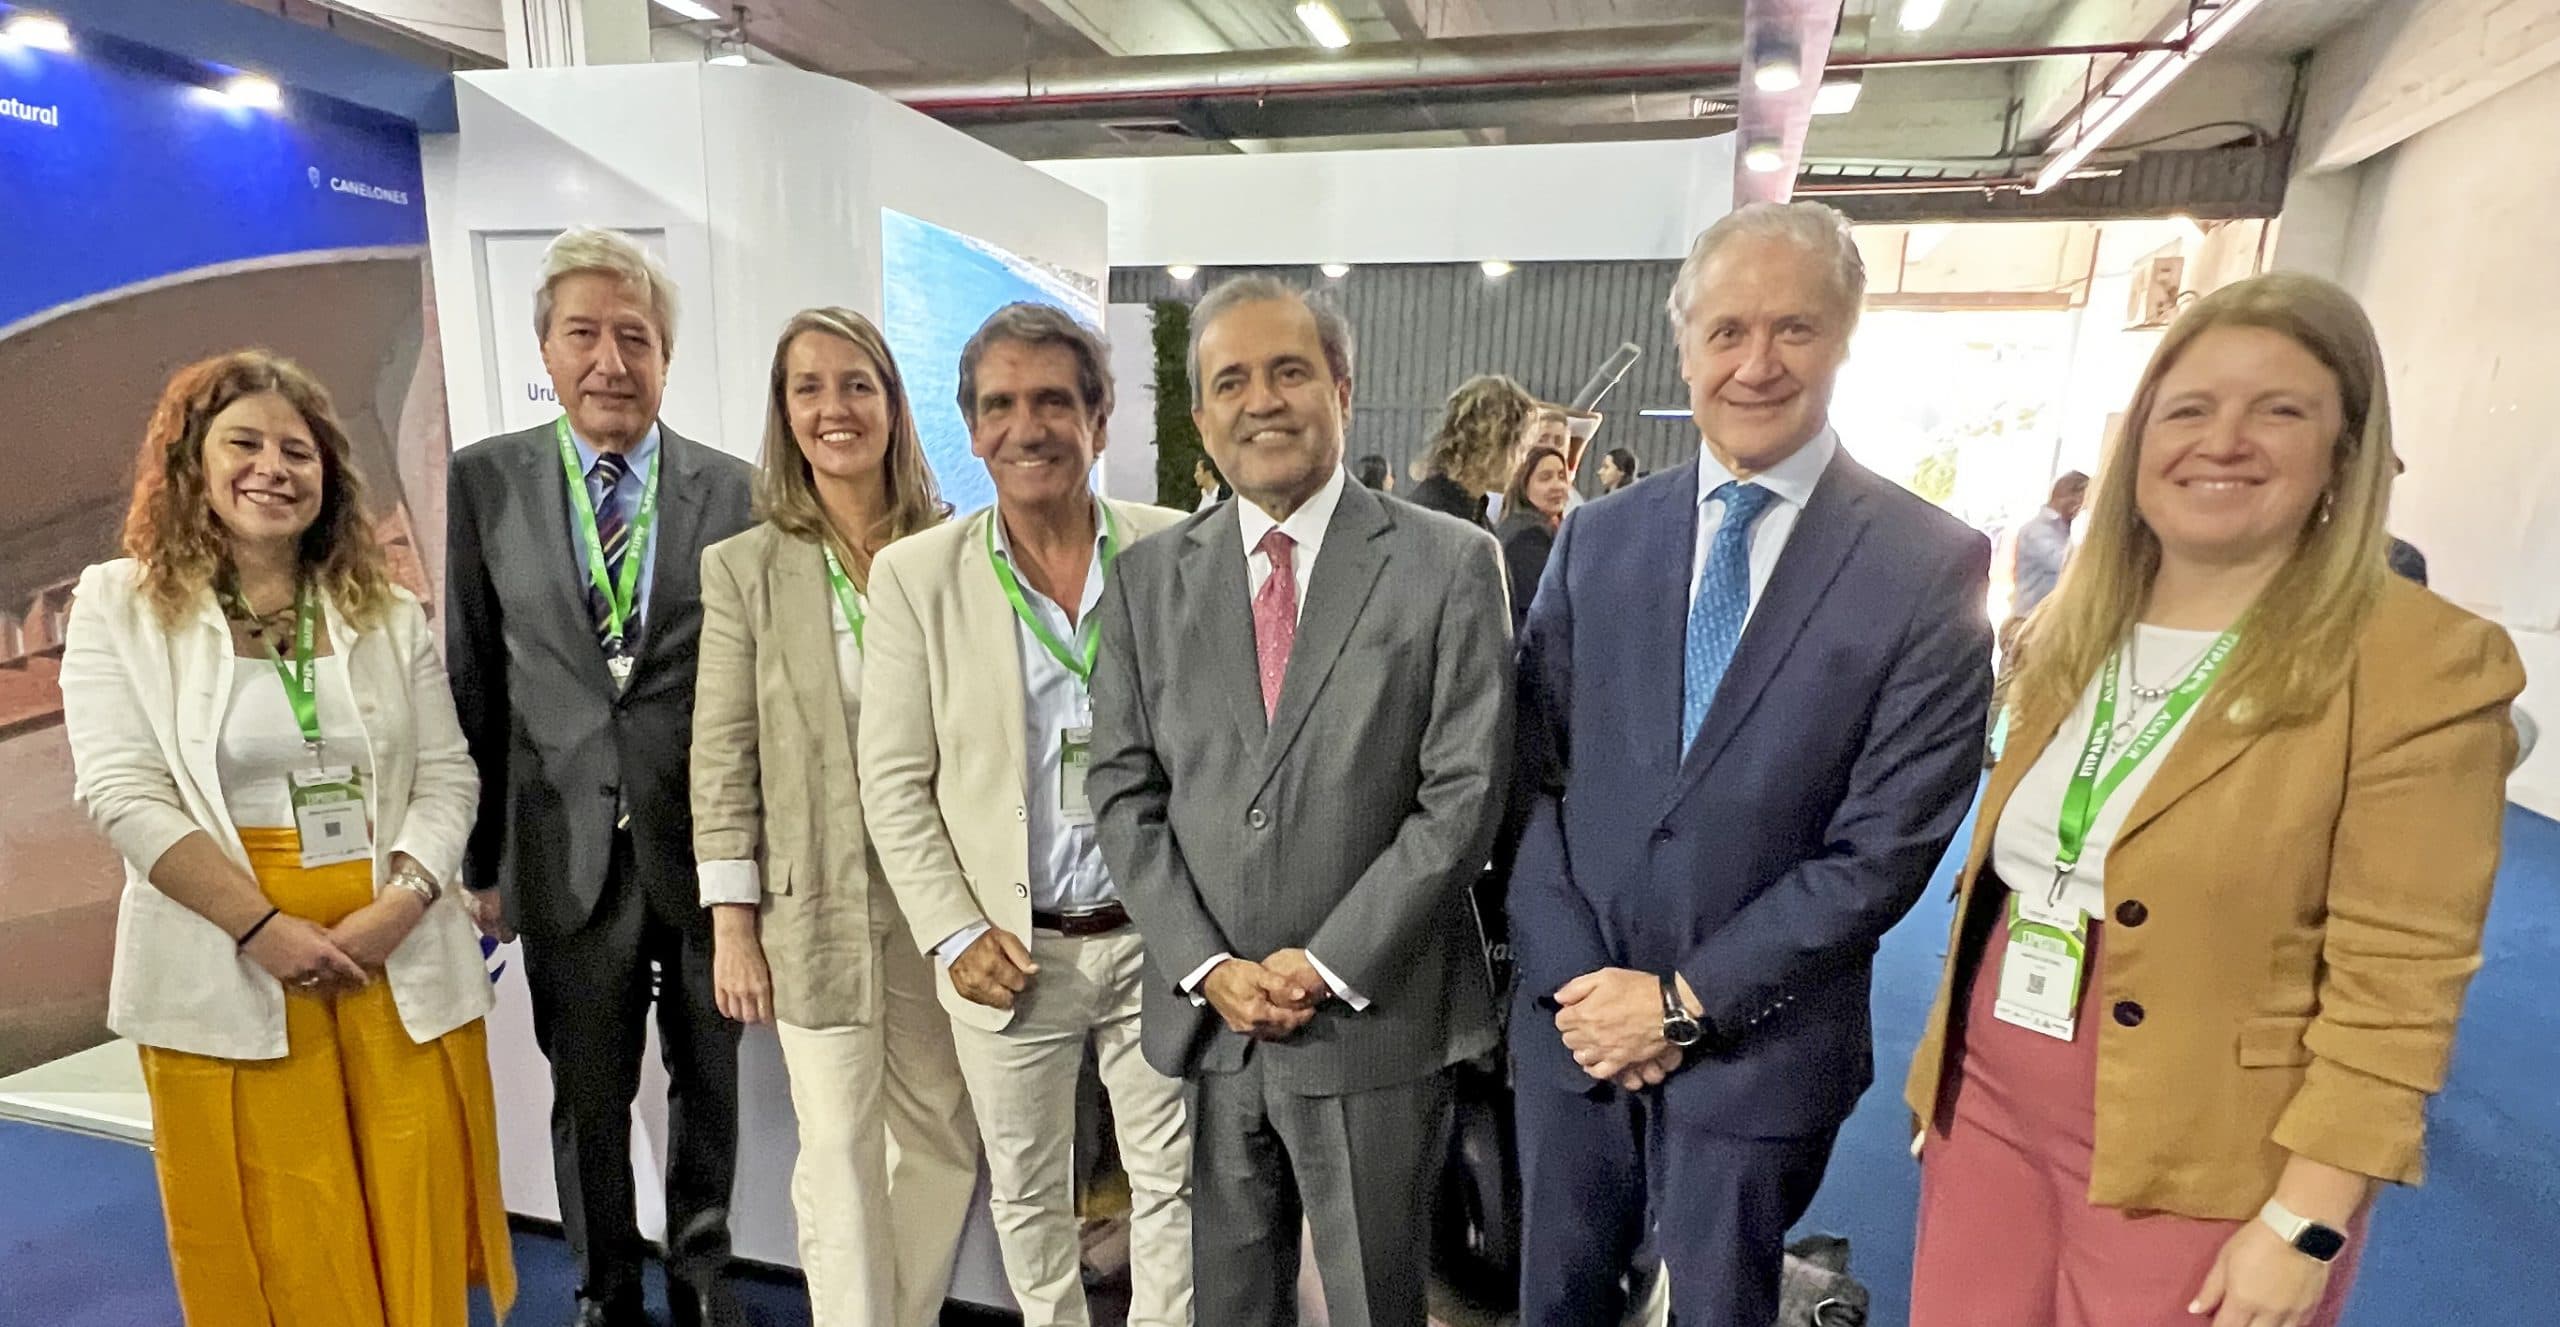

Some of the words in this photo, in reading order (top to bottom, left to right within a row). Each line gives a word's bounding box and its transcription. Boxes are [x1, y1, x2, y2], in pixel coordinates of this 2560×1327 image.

[0, 97, 59, 127] atural
[330, 176, 409, 205] CANELONES
[527, 382, 557, 404] Uru
